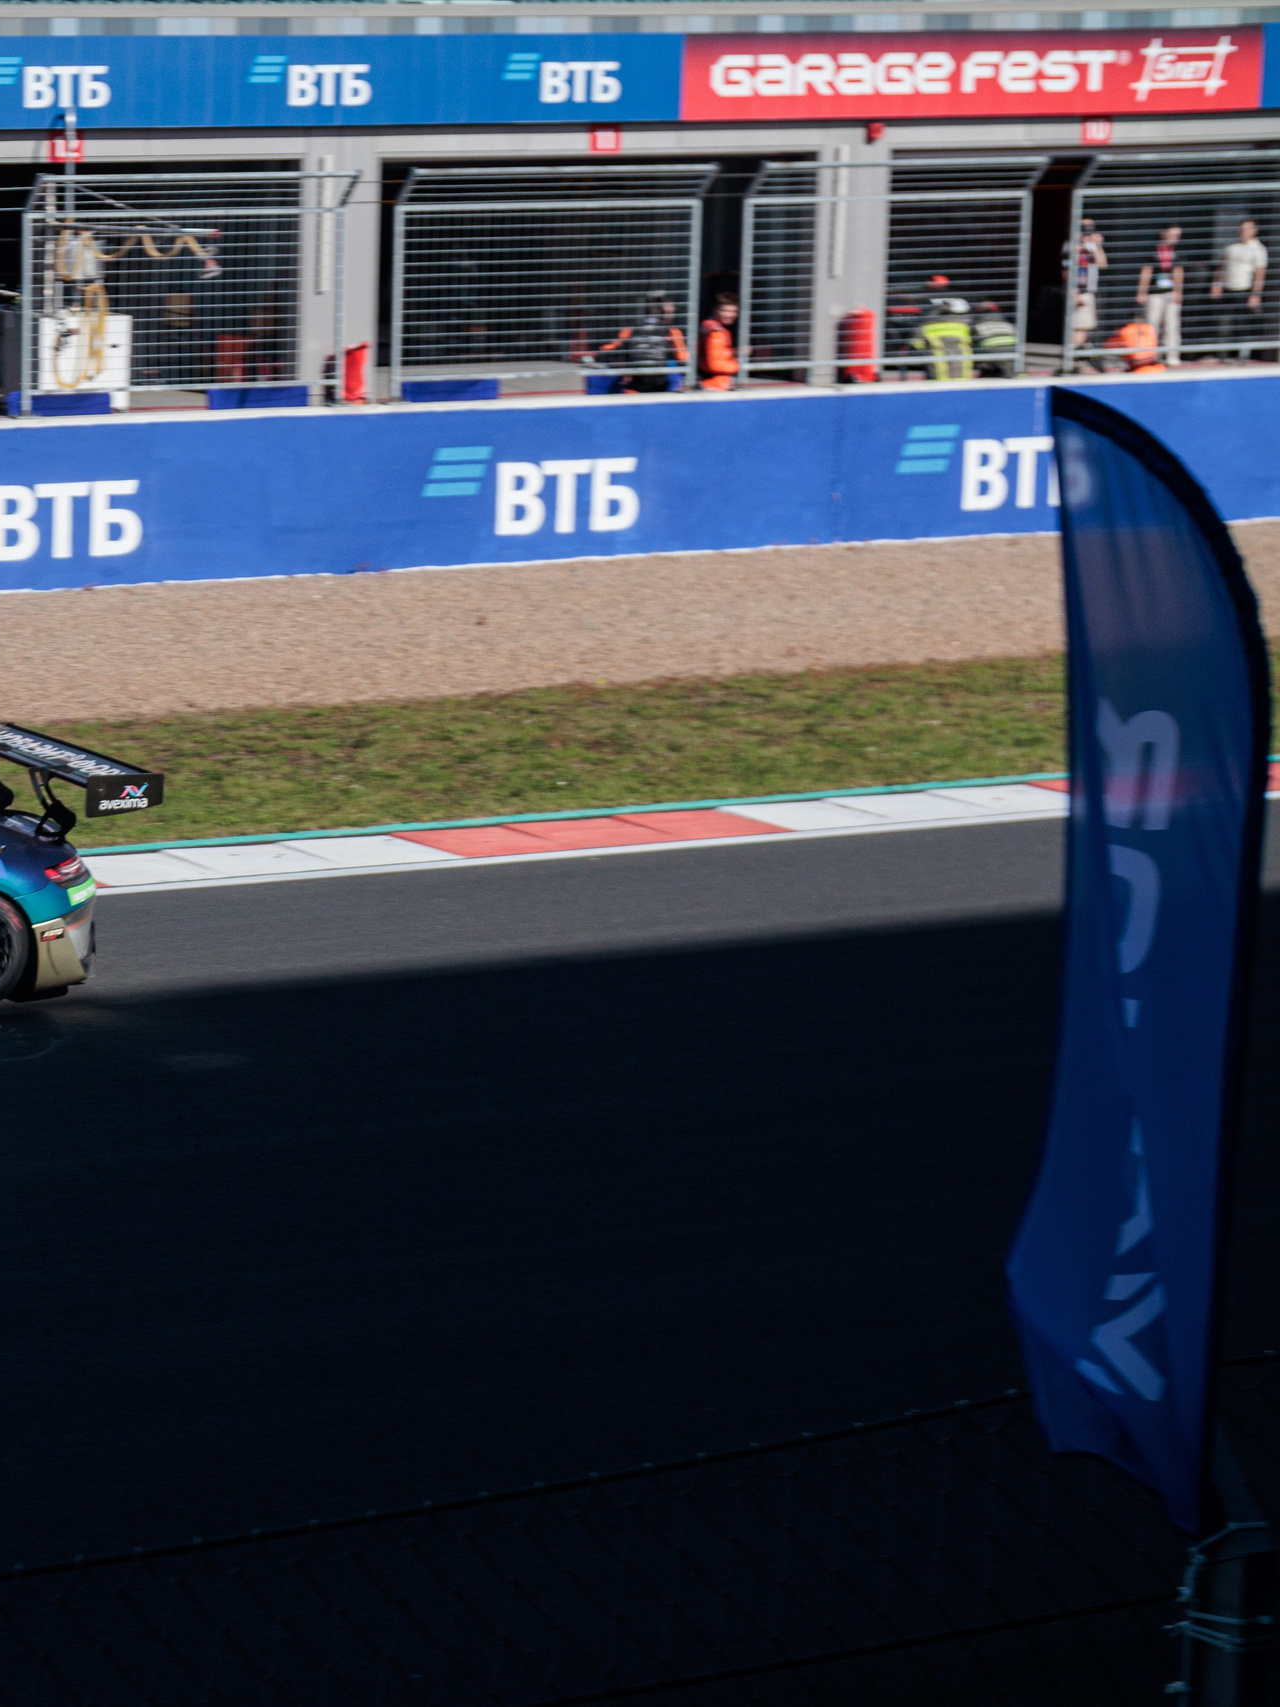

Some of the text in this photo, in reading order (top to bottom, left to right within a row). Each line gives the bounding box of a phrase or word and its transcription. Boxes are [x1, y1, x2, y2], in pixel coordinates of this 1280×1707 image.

[23, 65, 112, 109] ВТБ
[287, 63, 372, 107] ВТБ
[540, 61, 622, 104] ВТБ
[494, 457, 640, 536] ВТБ
[98, 796, 149, 811] avexima
